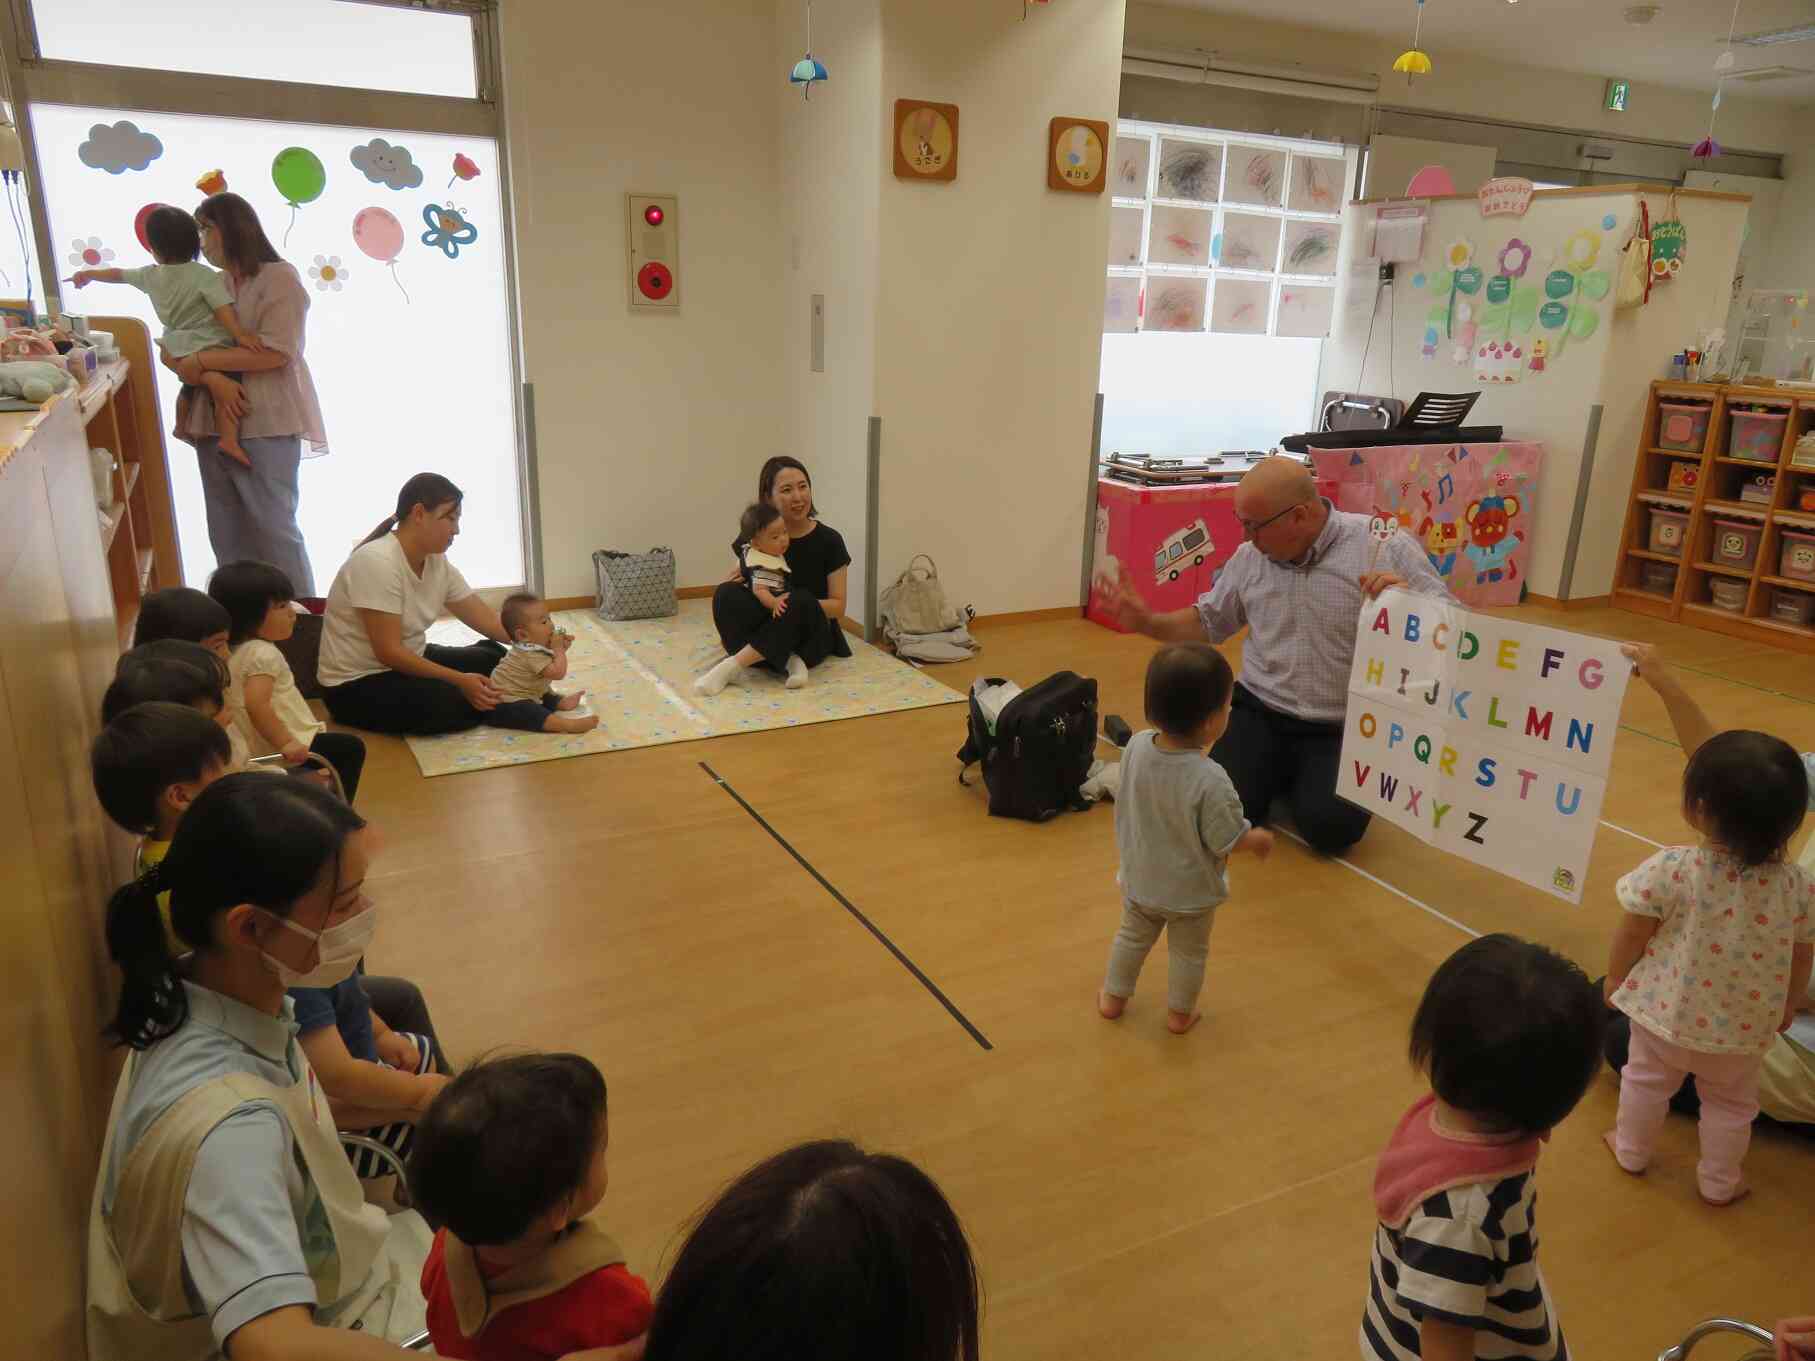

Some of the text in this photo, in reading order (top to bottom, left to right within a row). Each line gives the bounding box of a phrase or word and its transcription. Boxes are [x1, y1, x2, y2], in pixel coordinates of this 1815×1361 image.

[1372, 607, 1604, 690] A B C D E F G
[1365, 656, 1594, 754] H I J K L M N
[1354, 760, 1489, 845] V W X Y Z
[1359, 713, 1582, 816] O P Q R S T U
